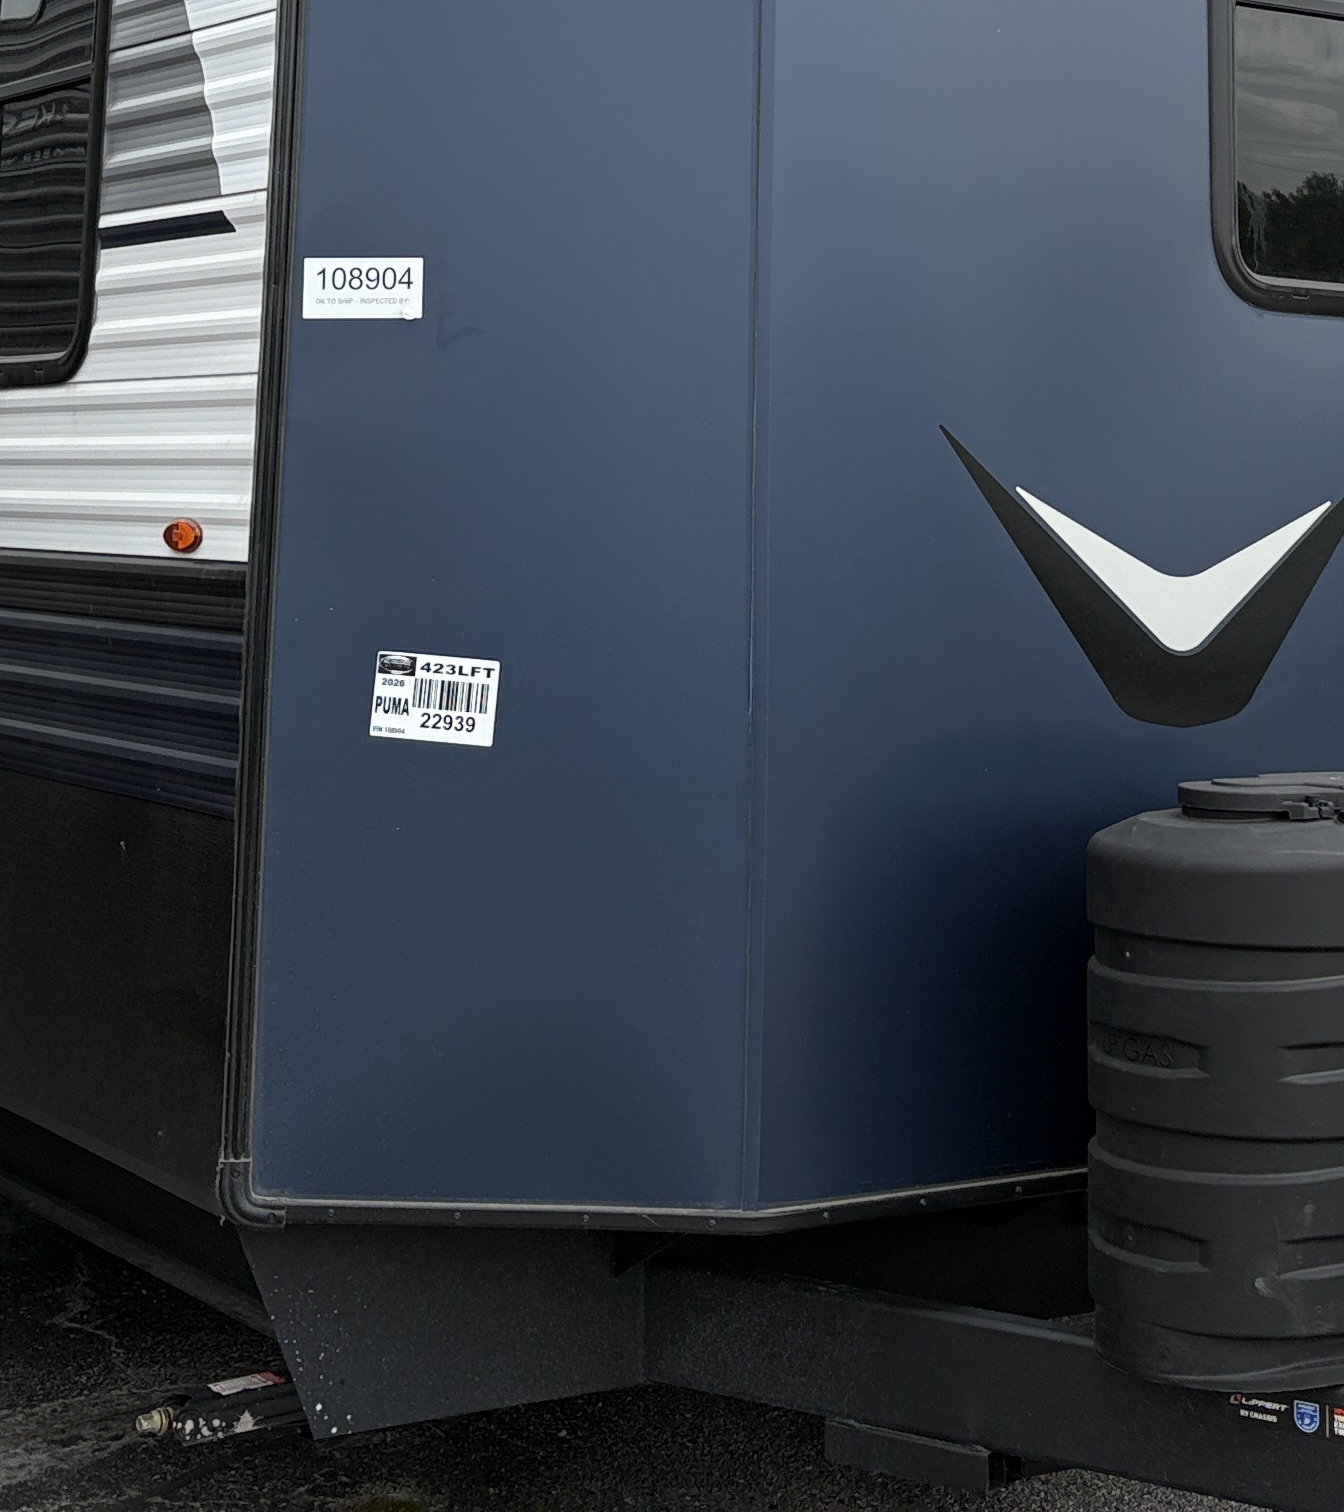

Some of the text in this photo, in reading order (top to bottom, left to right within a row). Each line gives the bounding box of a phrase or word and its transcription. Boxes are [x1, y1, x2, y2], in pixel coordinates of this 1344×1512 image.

[316, 267, 414, 290] 108904
[327, 297, 336, 305] TO
[420, 662, 496, 679] 423LFT
[381, 678, 406, 687] 2026
[374, 695, 410, 716] PUMA
[419, 712, 476, 733] 22939
[1123, 1037, 1173, 1068] GAS
